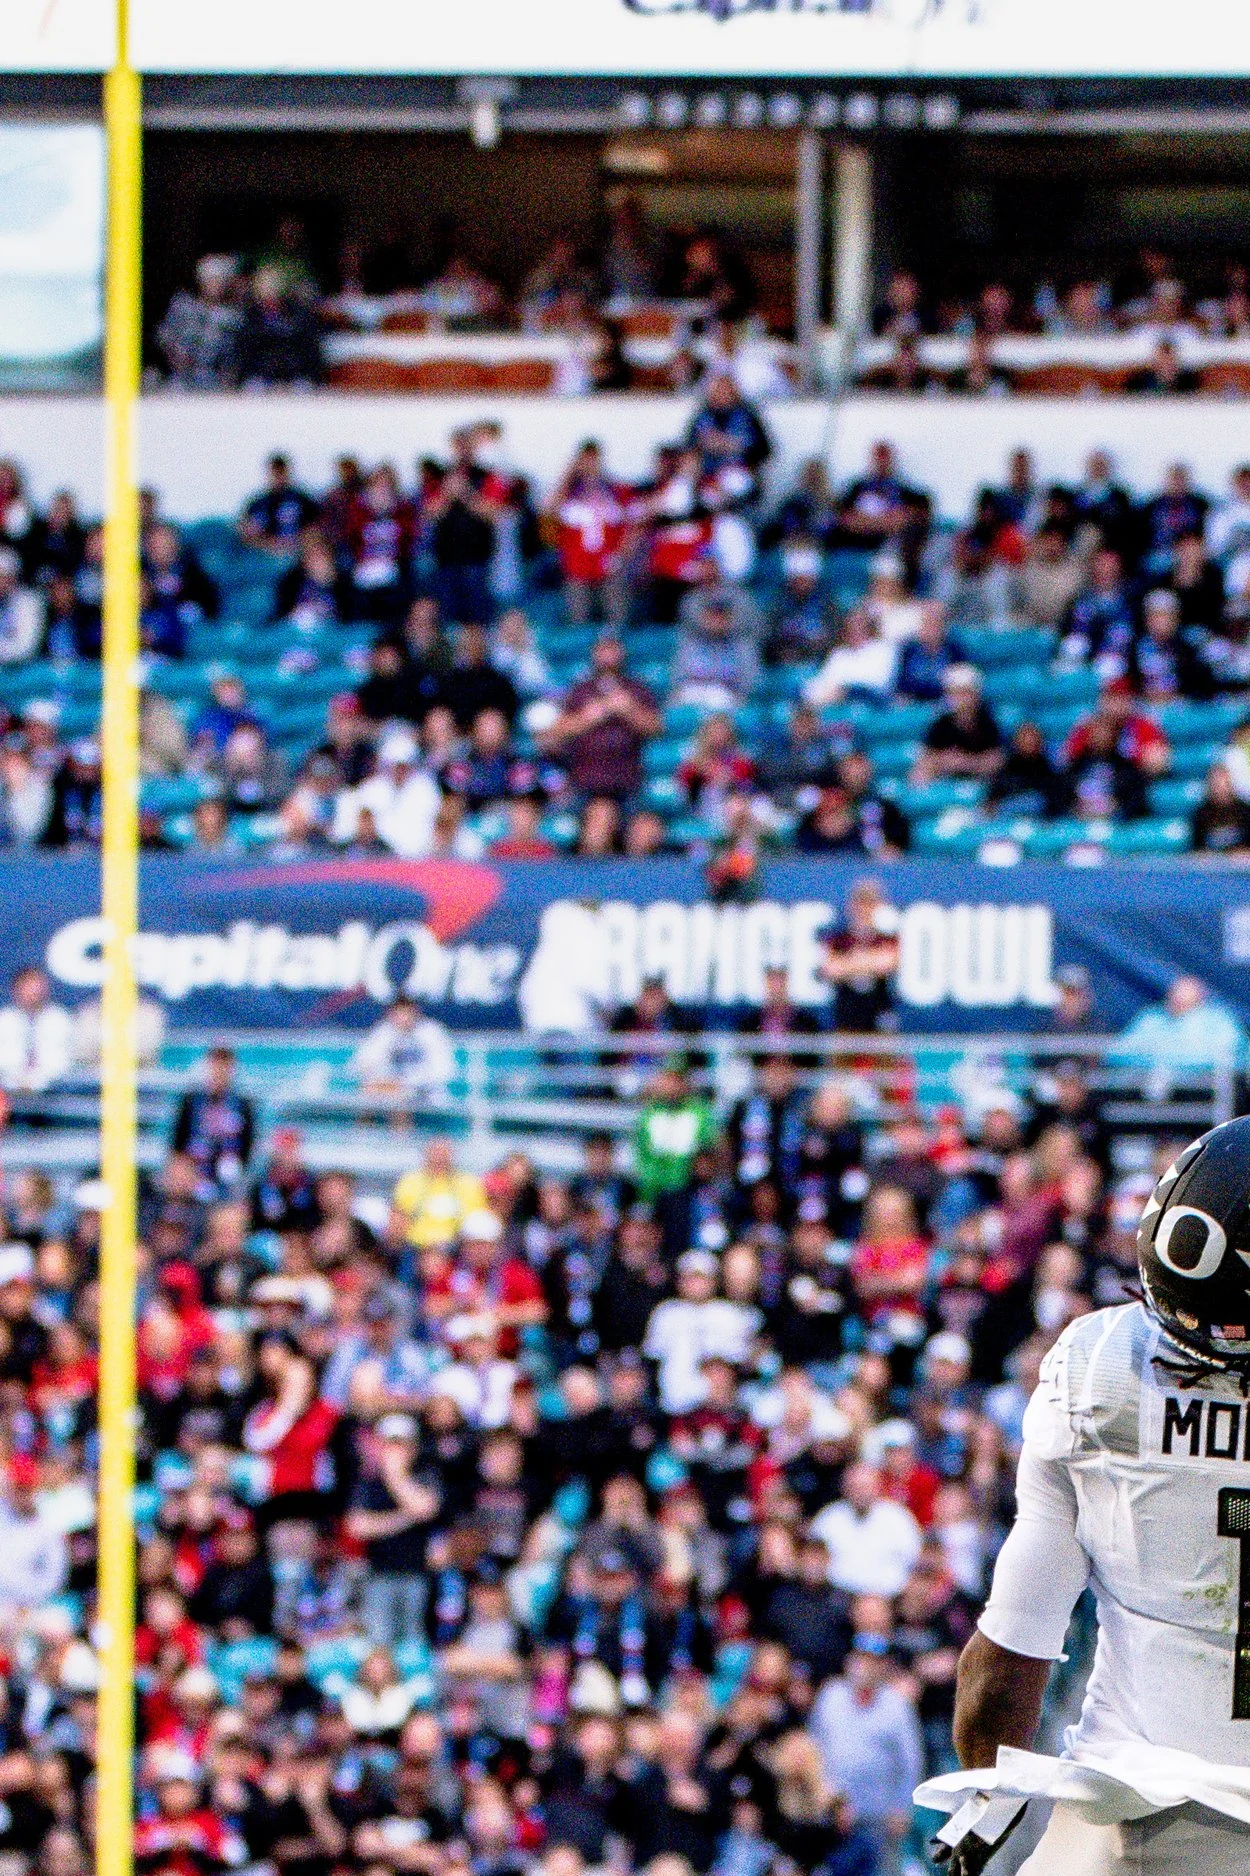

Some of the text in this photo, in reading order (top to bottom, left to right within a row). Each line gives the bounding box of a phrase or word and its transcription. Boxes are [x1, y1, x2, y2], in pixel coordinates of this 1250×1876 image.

[596, 902, 1057, 1008] RANGE OWL
[1154, 1205, 1228, 1280] O
